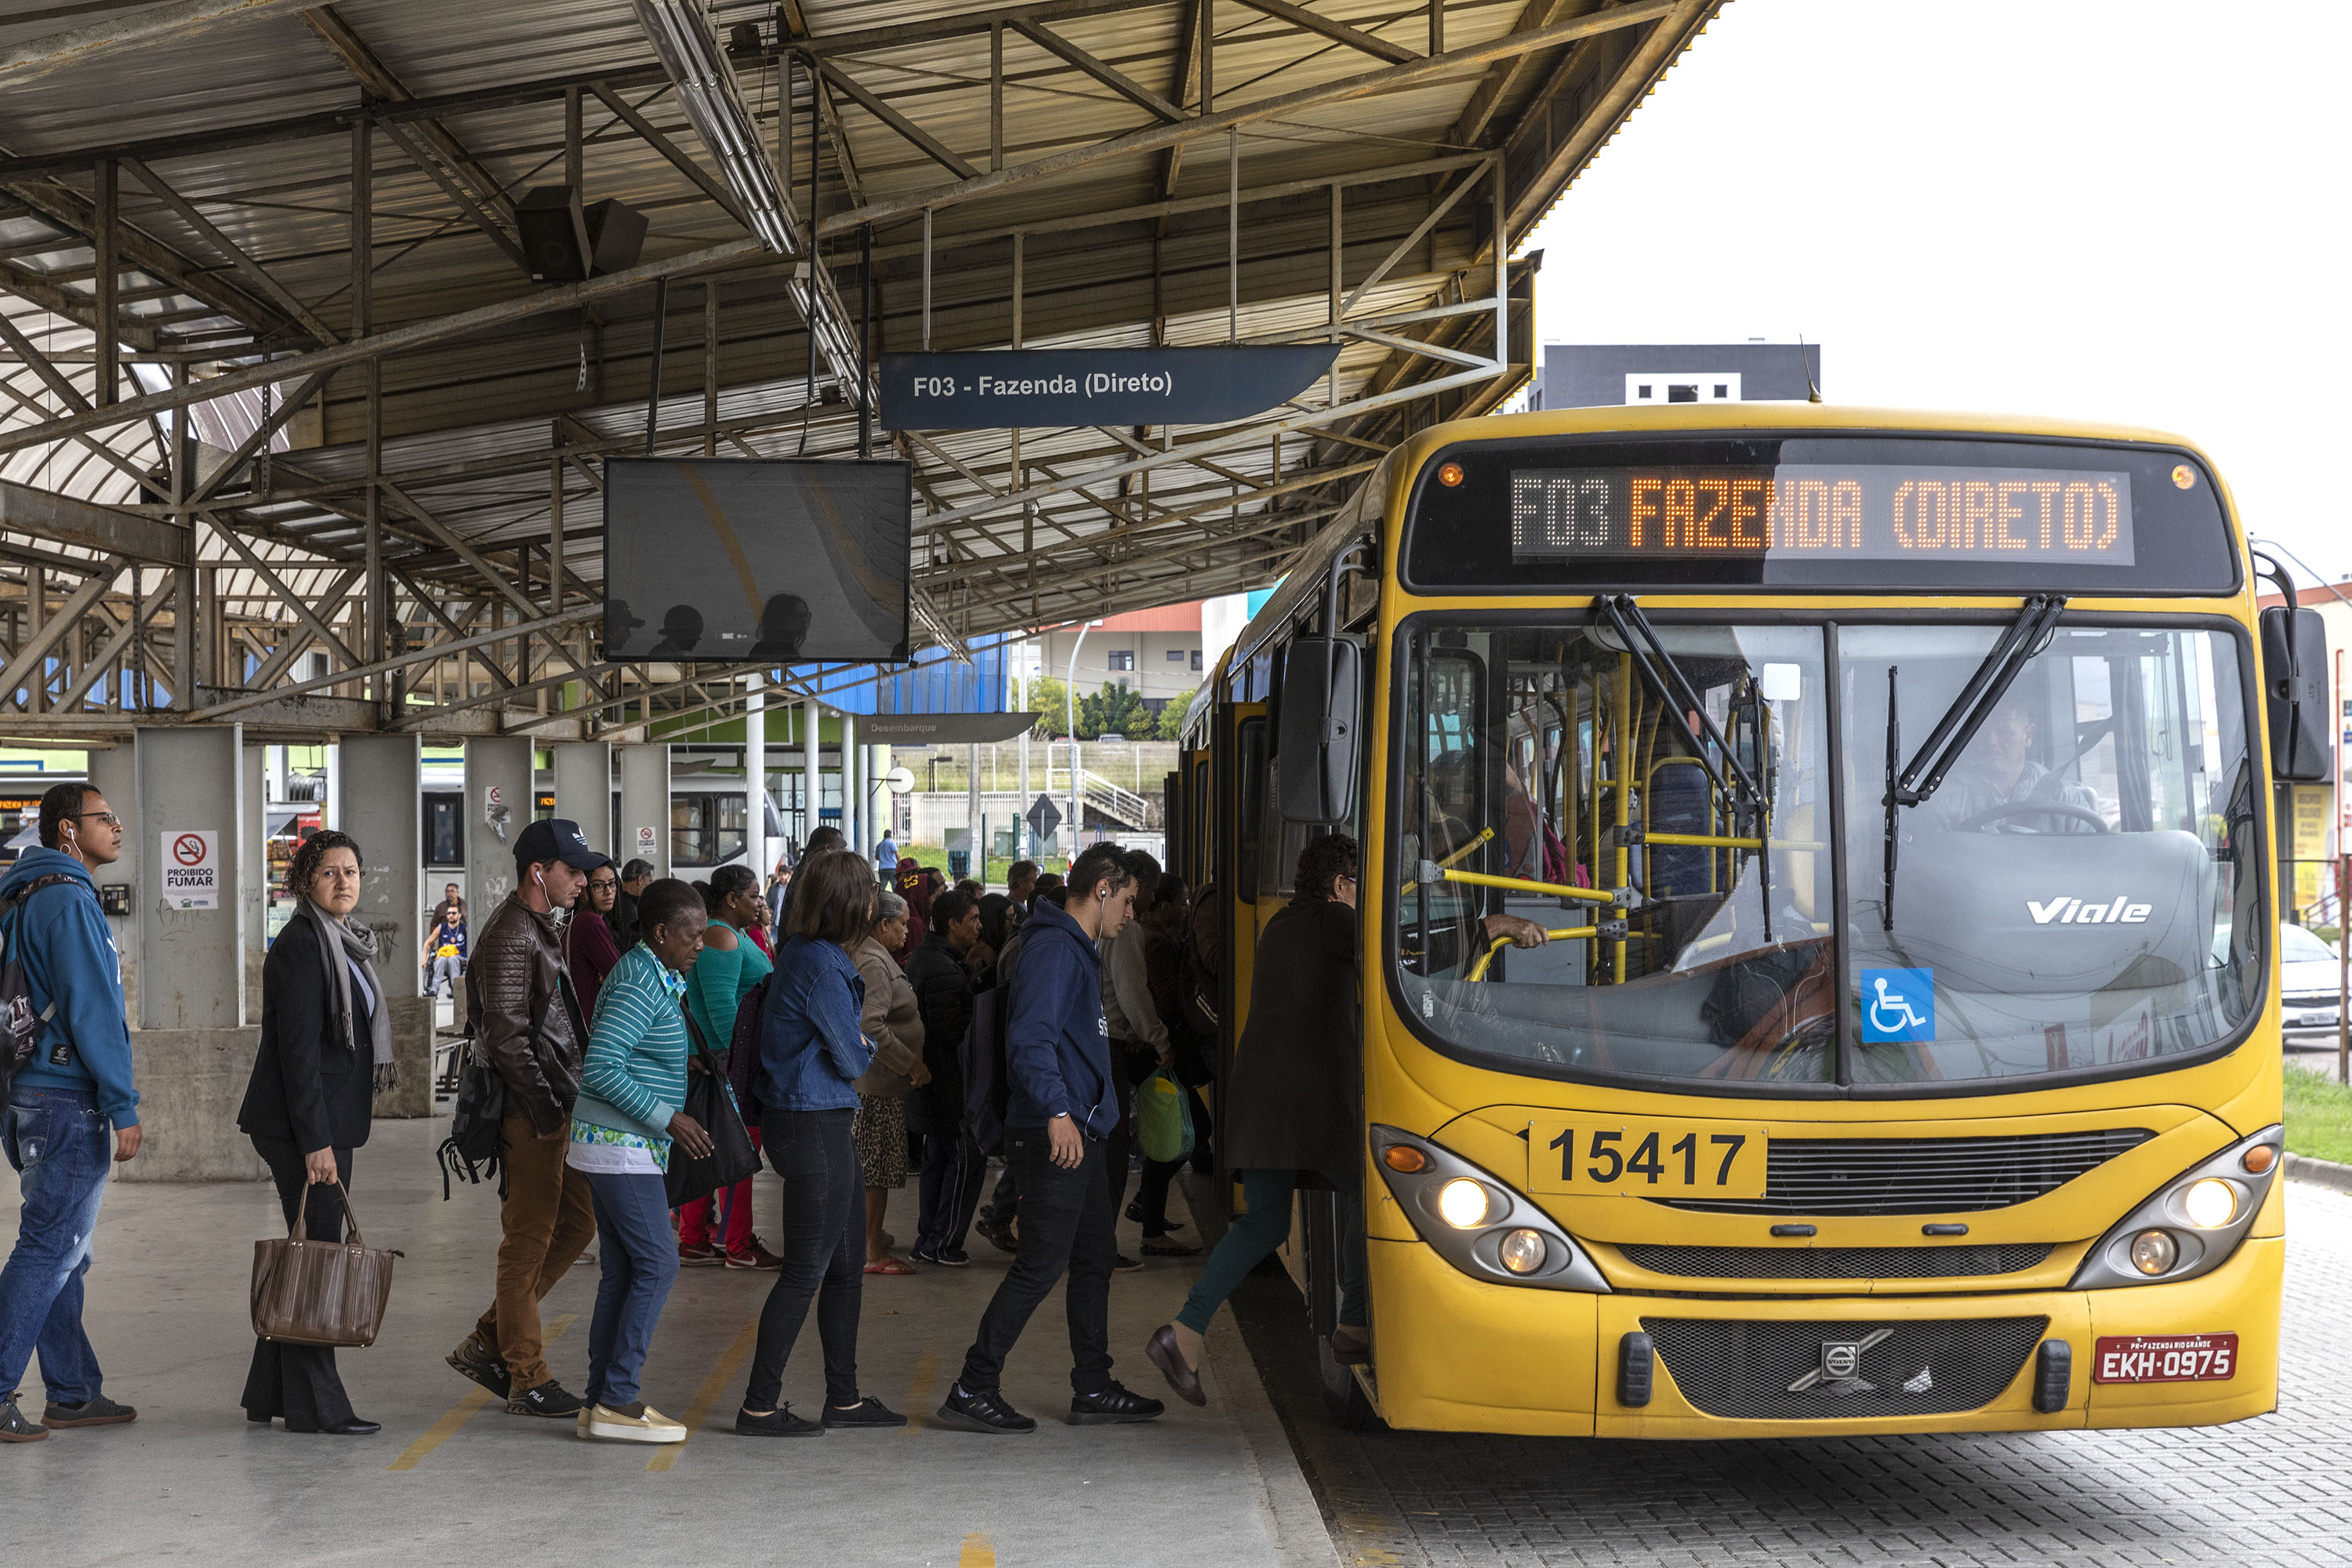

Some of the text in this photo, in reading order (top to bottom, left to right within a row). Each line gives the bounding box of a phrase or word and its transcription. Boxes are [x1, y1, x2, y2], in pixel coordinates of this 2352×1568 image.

[913, 376, 956, 397] F03
[978, 374, 1077, 396] Fazenda
[1085, 371, 1172, 398] (Direto)
[1513, 478, 2118, 550] F03 FAZENDA (DIRETO)
[871, 724, 937, 734] Desembarque
[167, 868, 213, 877] PROIBIDO
[167, 877, 213, 887] FUMAR
[2025, 895, 2153, 924] Viale
[1549, 1128, 1747, 1186] 15417
[2186, 1340, 2212, 1348] GRANDE
[489, 1363, 505, 1379] FILA
[528, 1390, 545, 1403] FILA
